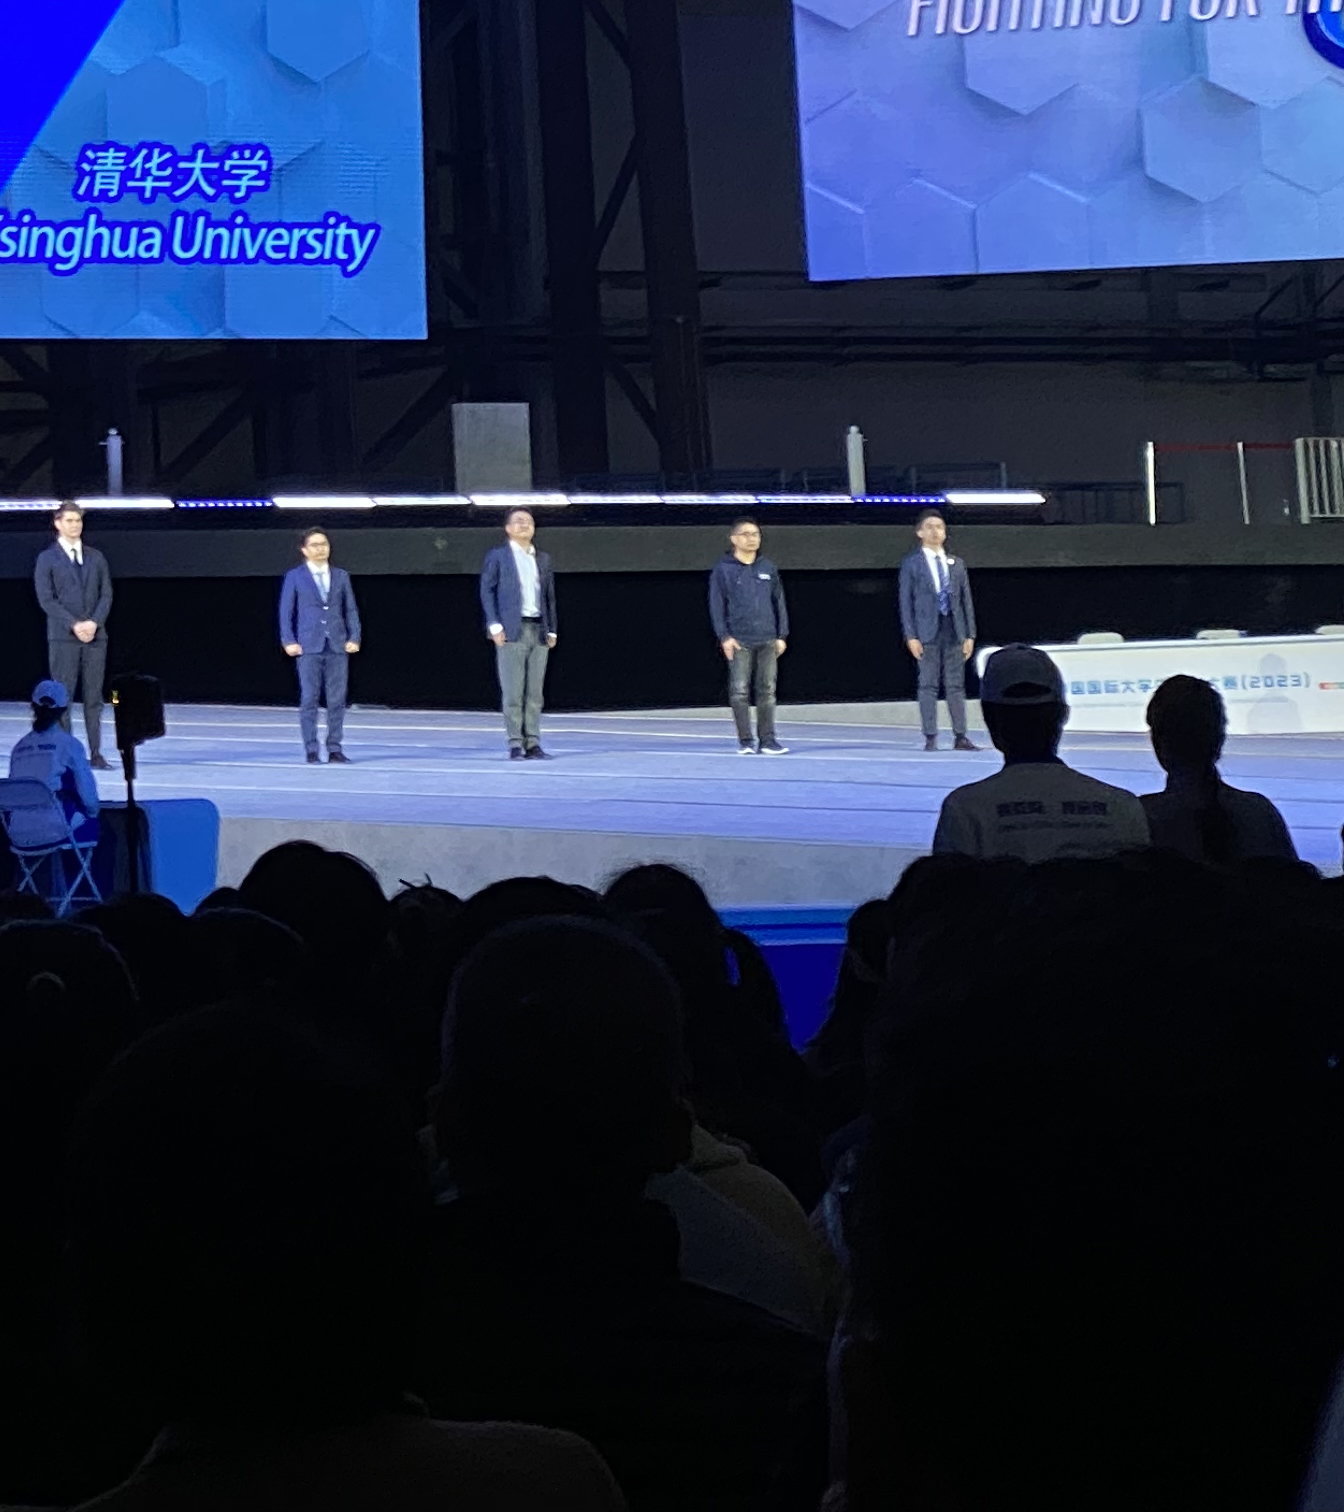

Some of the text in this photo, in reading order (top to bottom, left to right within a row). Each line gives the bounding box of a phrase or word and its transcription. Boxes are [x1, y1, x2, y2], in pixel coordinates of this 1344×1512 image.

[77, 148, 269, 199] 清华大学
[173, 216, 376, 273] University
